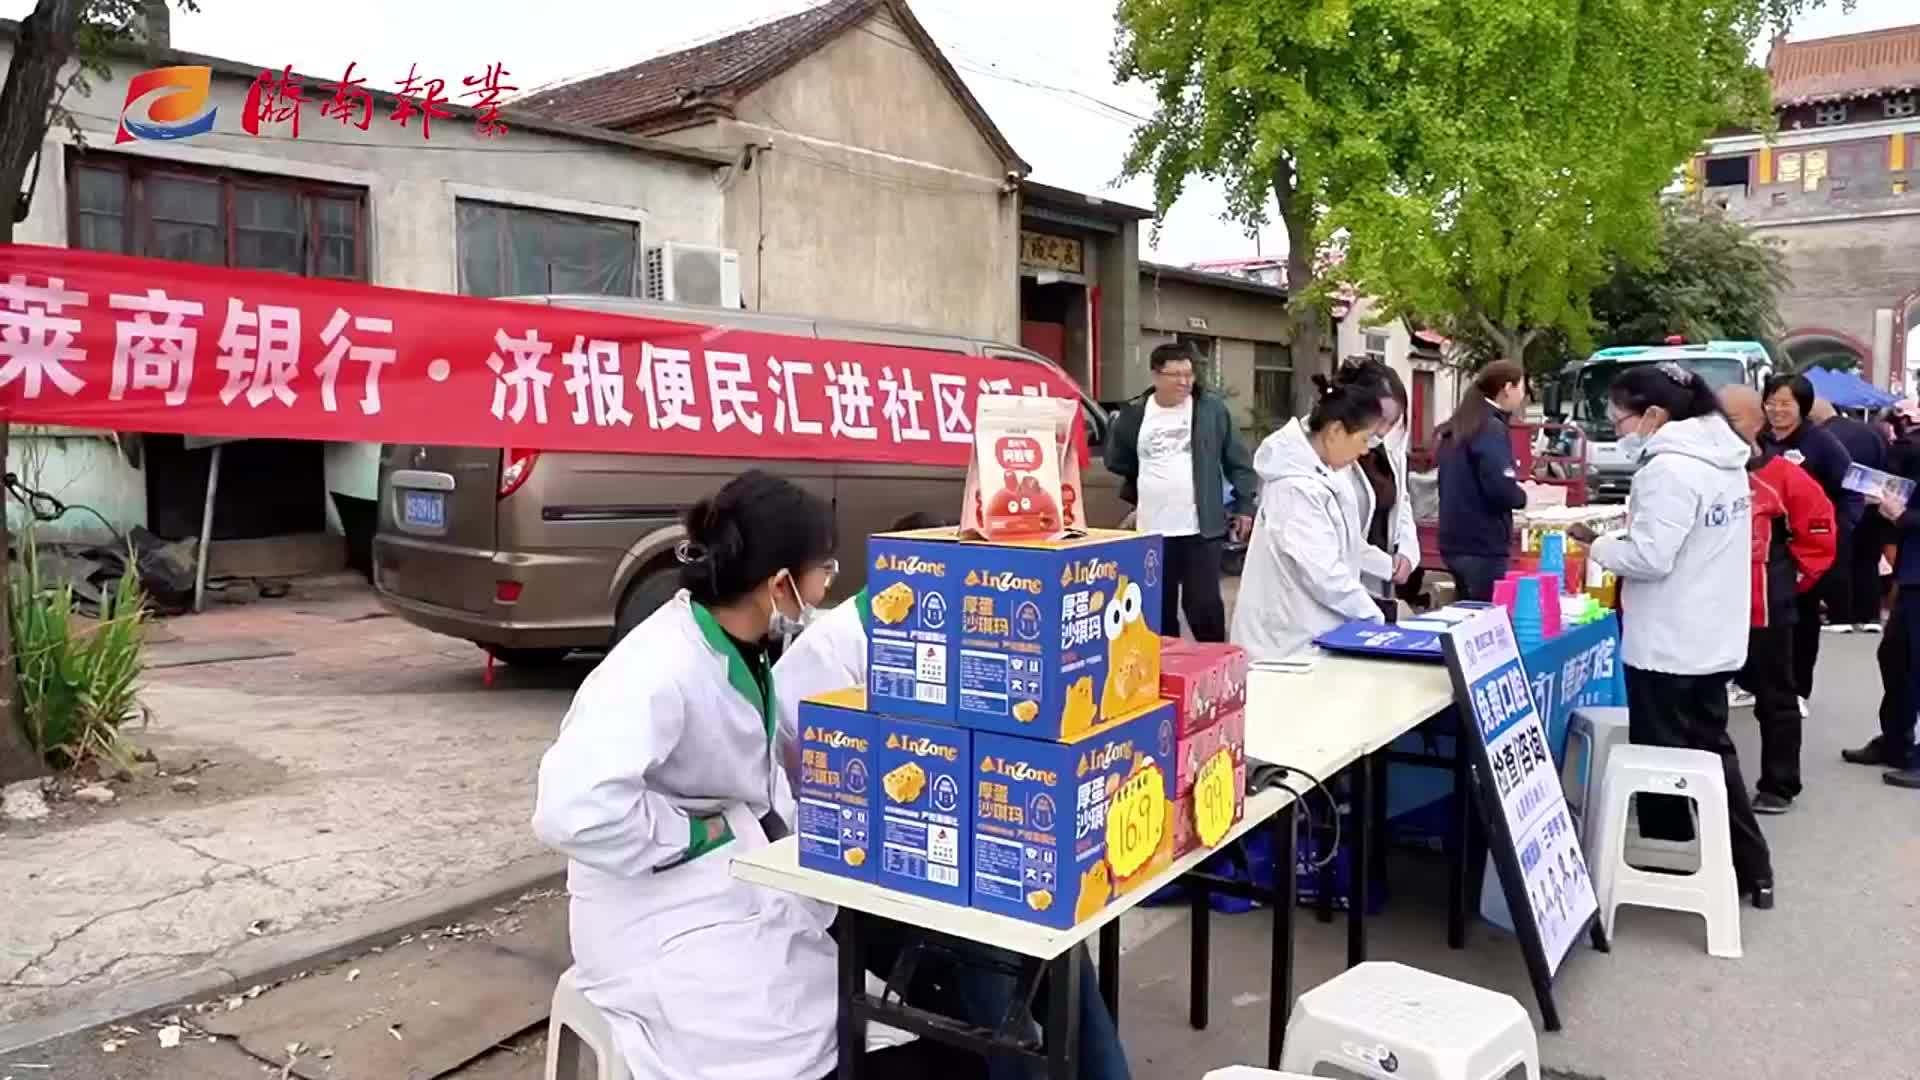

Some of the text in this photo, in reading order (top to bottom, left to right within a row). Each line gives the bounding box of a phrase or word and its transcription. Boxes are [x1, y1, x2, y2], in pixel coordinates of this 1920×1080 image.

[890, 554, 946, 577] InZone
[981, 570, 1043, 594] InZone
[1061, 614, 1102, 650] 沙琪玛
[816, 727, 869, 752] InZone
[901, 735, 960, 761] InZone
[996, 757, 1057, 787] InZone
